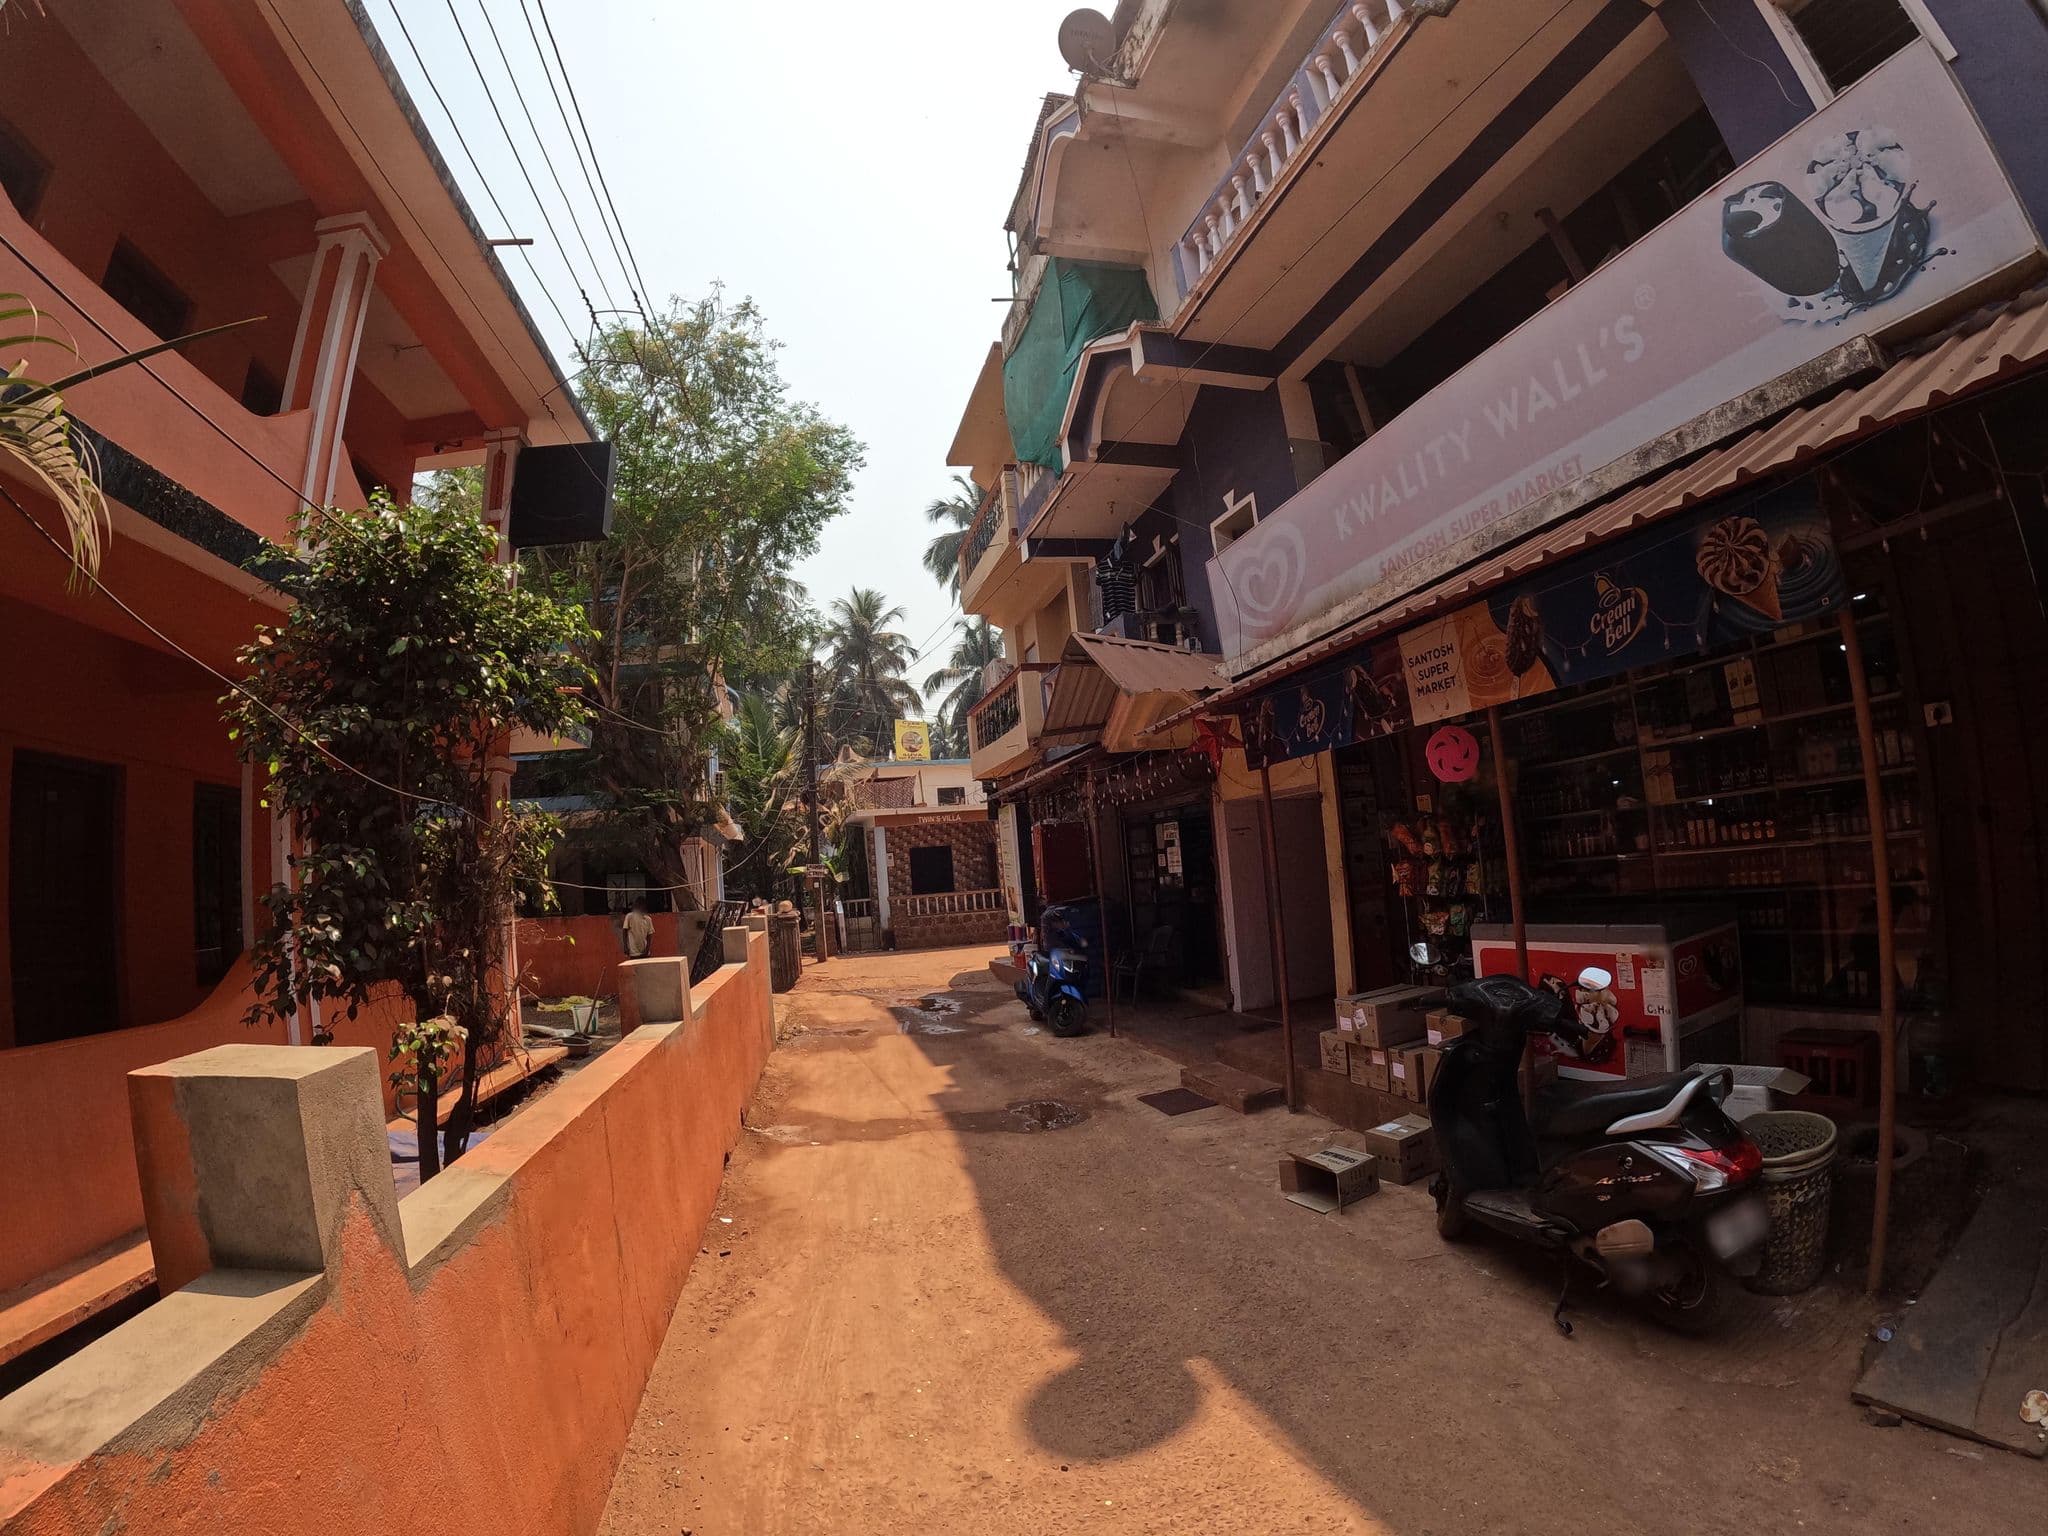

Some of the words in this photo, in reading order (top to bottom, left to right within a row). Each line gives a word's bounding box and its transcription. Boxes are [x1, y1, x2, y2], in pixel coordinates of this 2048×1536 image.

[1334, 420, 1472, 542] KWALITY
[1482, 314, 1645, 441] WALL'S
[1378, 530, 1447, 578] SANTOSH
[1450, 503, 1504, 538] SUPER
[1506, 454, 1586, 508] MARKET
[1590, 597, 1635, 634] Cream
[1408, 643, 1455, 668] SANTOSH
[1418, 662, 1449, 680] SUPER
[1417, 676, 1456, 697] MARKET
